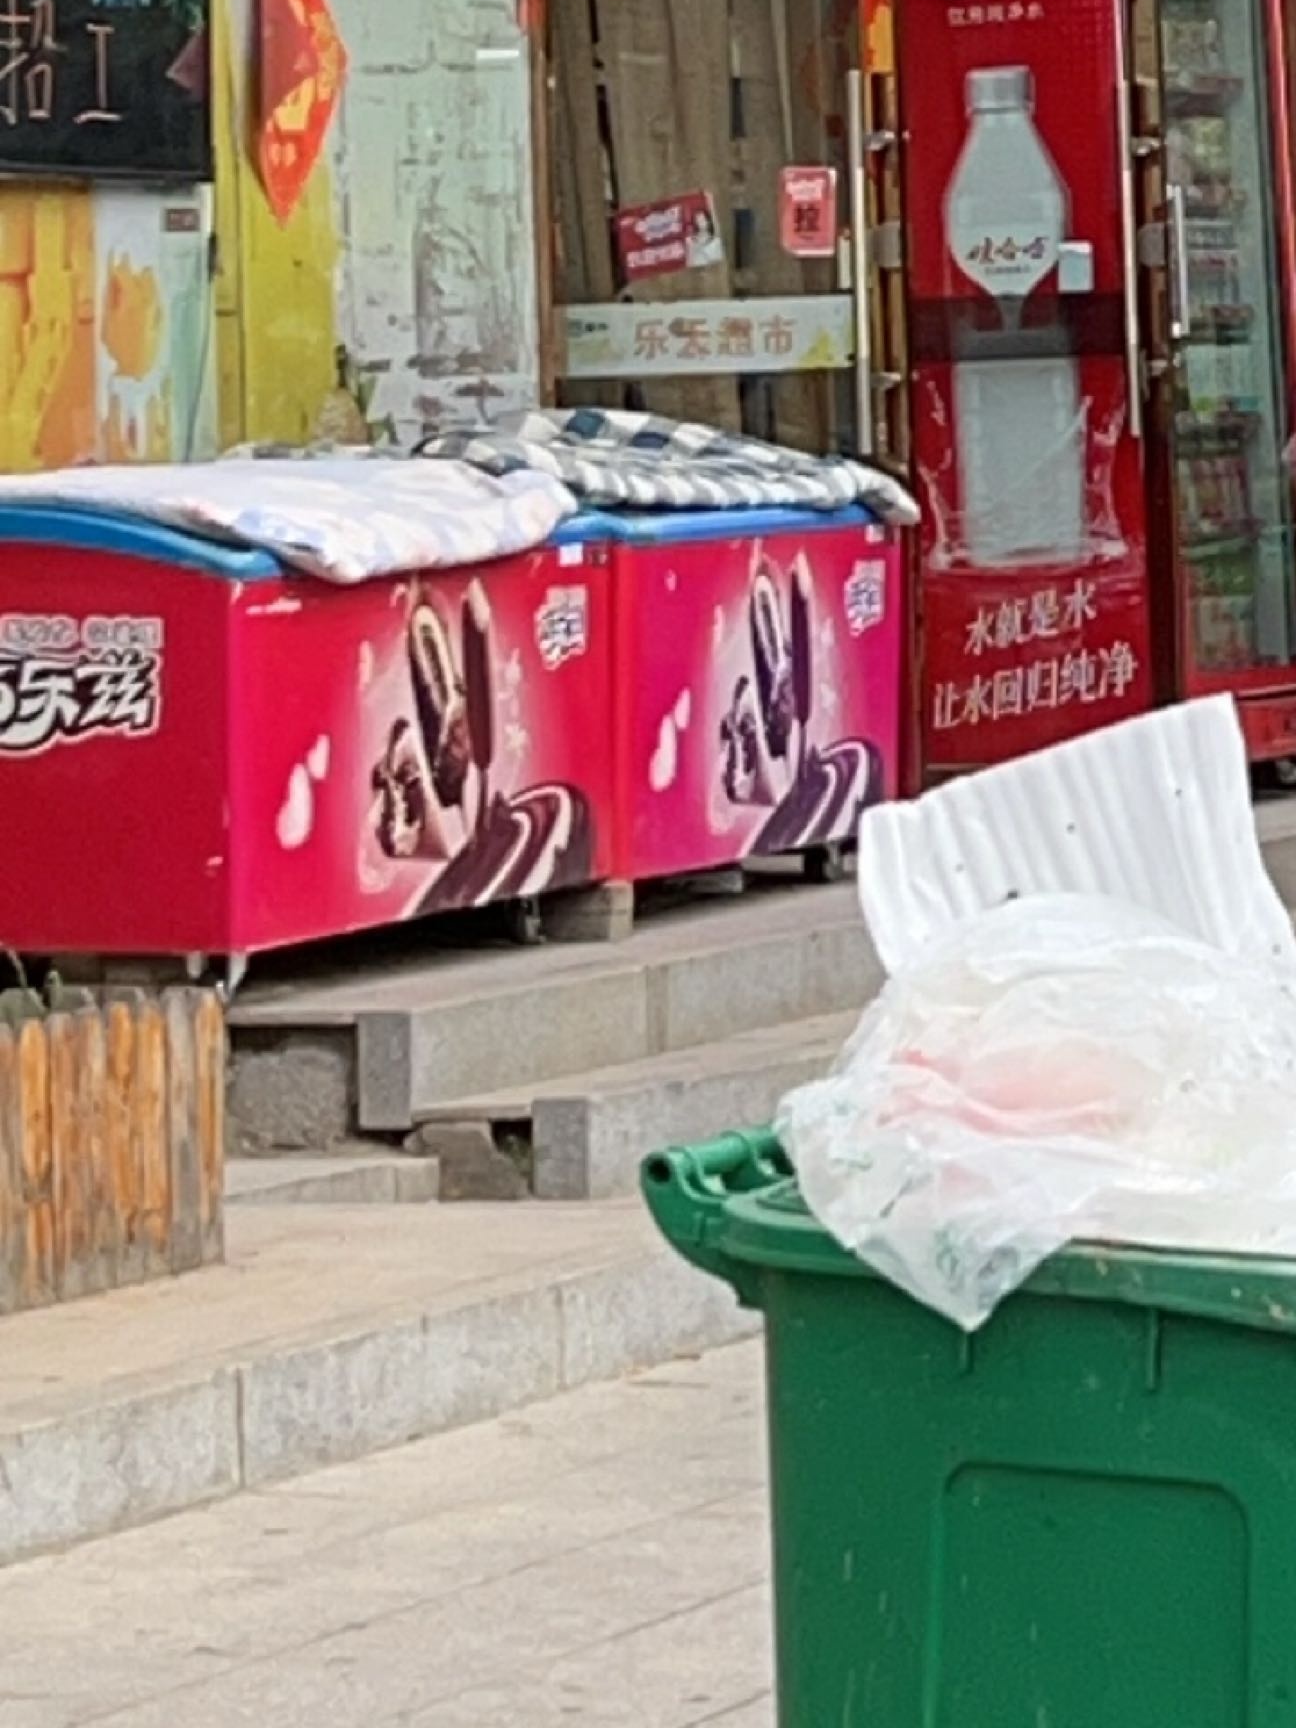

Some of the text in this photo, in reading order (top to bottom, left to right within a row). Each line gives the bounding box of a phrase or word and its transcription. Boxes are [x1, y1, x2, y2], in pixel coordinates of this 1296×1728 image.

[963, 577, 1098, 657] 水就是水
[932, 639, 1139, 731] 让水回归纯净
